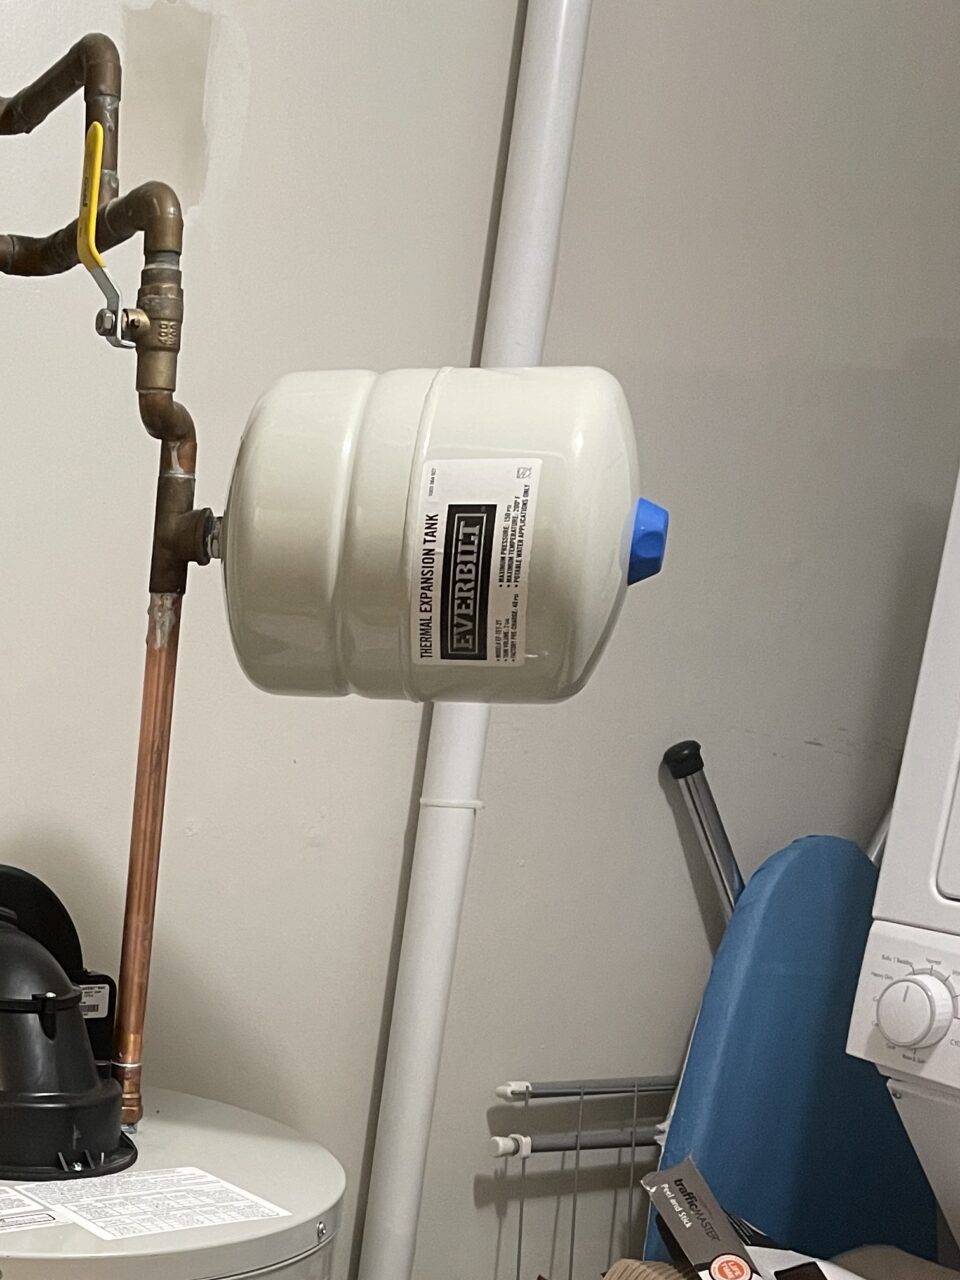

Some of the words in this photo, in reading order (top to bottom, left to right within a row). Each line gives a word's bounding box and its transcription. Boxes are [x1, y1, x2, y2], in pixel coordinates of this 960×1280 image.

[522, 484, 530, 498] ONLY
[423, 513, 439, 544] TANK
[517, 498, 529, 538] APPLICATIONS
[500, 523, 510, 555] PRESSURE:
[508, 513, 518, 556] TEMPERATURE:
[516, 538, 524, 558] WATER
[420, 547, 435, 613] EXPANSION
[453, 521, 480, 649] EVERBILT
[498, 556, 507, 583] MAXIMUM
[506, 557, 515, 583] MAXIMUM
[514, 559, 523, 583] POTABLE
[420, 617, 433, 658] THERMAL
[661, 1184, 673, 1199] Peel
[670, 1197, 681, 1211] and
[679, 1211, 692, 1229] Stick
